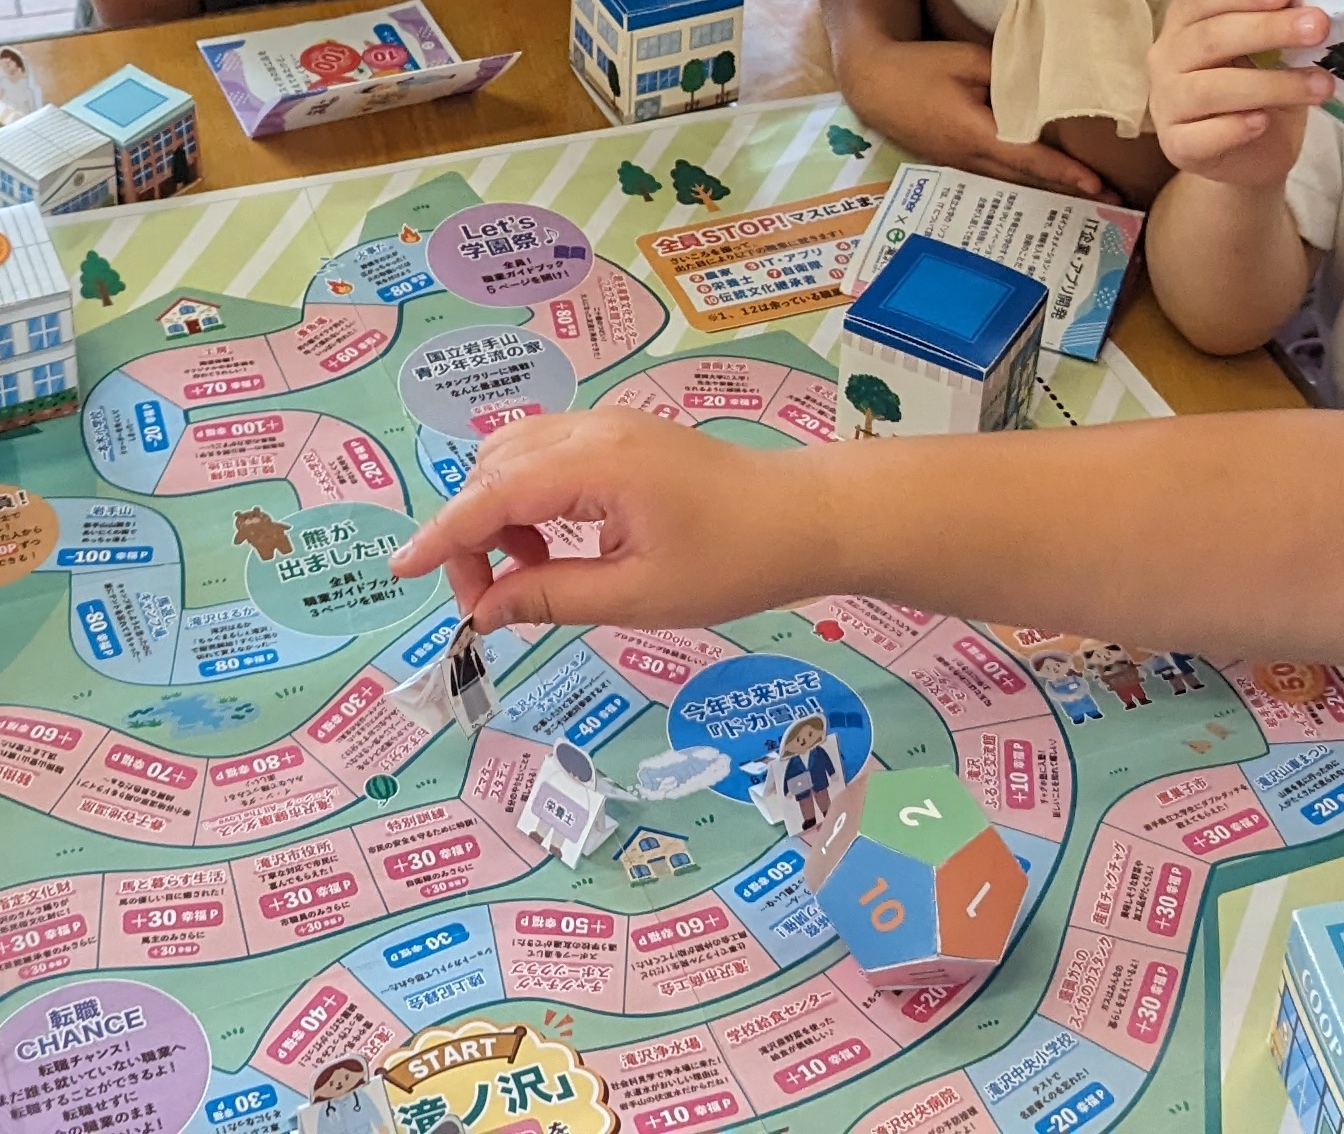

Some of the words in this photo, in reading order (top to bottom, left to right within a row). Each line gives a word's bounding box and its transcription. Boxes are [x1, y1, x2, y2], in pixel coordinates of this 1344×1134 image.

[905, 177, 930, 214] brother
[462, 216, 537, 241] Let's
[458, 232, 540, 261] 学園祭
[326, 347, 359, 370] +60
[412, 338, 545, 381] 青少年交流の家
[425, 332, 519, 365] 国立岩手山
[191, 381, 228, 396] +70
[690, 395, 726, 408] +20
[230, 419, 281, 436] +100
[787, 409, 819, 429] +20
[359, 461, 386, 487] +20
[92, 504, 134, 517] 岩手山
[301, 520, 358, 551] 熊が
[65, 549, 112, 564] -100
[85, 605, 108, 632] -80
[205, 658, 240, 673] -80
[625, 652, 662, 673] +30
[984, 663, 1016, 688] +10
[339, 684, 373, 717] +30
[681, 670, 821, 722] 今年も来たぞ
[30, 724, 74, 745] +60
[573, 715, 602, 742] -40
[146, 761, 188, 785] +70
[252, 750, 297, 774] +80
[1011, 772, 1030, 804] +10
[385, 807, 449, 833] 特別訓練
[898, 798, 943, 827] 2
[1311, 797, 1340, 818] -20
[1192, 825, 1232, 849] +30
[255, 839, 334, 871] 滝沢市役所
[393, 848, 437, 873] +30
[121, 869, 227, 894] 馬と暮らす生活
[768, 858, 799, 880] -60
[1091, 841, 1129, 928] 産直チャグチャグ
[268, 887, 314, 913] +30
[859, 877, 905, 933] 10
[965, 880, 993, 919] 1
[1154, 895, 1179, 930] +30
[130, 909, 178, 928] +30
[561, 916, 607, 934] +50
[675, 913, 721, 939] +60
[510, 965, 612, 980] スポーツクラブ
[515, 979, 604, 993] チャグチャグ
[659, 958, 752, 996] 滝沢市商工会
[1058, 949, 1090, 1006] 盛岡ガスの
[1068, 935, 1114, 1029] スイカのガスタンク
[407, 970, 487, 1012] 陸上記録会
[48, 998, 102, 1029] 転職
[299, 993, 338, 1032] +40
[725, 990, 834, 1045] 学校給食センター
[1135, 995, 1162, 1035] +30
[1301, 969, 1343, 1056] COOP
[15, 1006, 145, 1062] CHANCE
[37, 1040, 131, 1077] 転職チャンス！
[407, 1037, 497, 1080] START
[620, 1035, 702, 1068] 滝沢浄水場
[785, 1058, 828, 1088] +10
[983, 1030, 1078, 1101] 滝沢中央小学校
[61, 1090, 140, 1123] 転職せずに
[234, 1091, 271, 1113] -30
[644, 1106, 690, 1130] +10
[1046, 1108, 1079, 1133] -20
